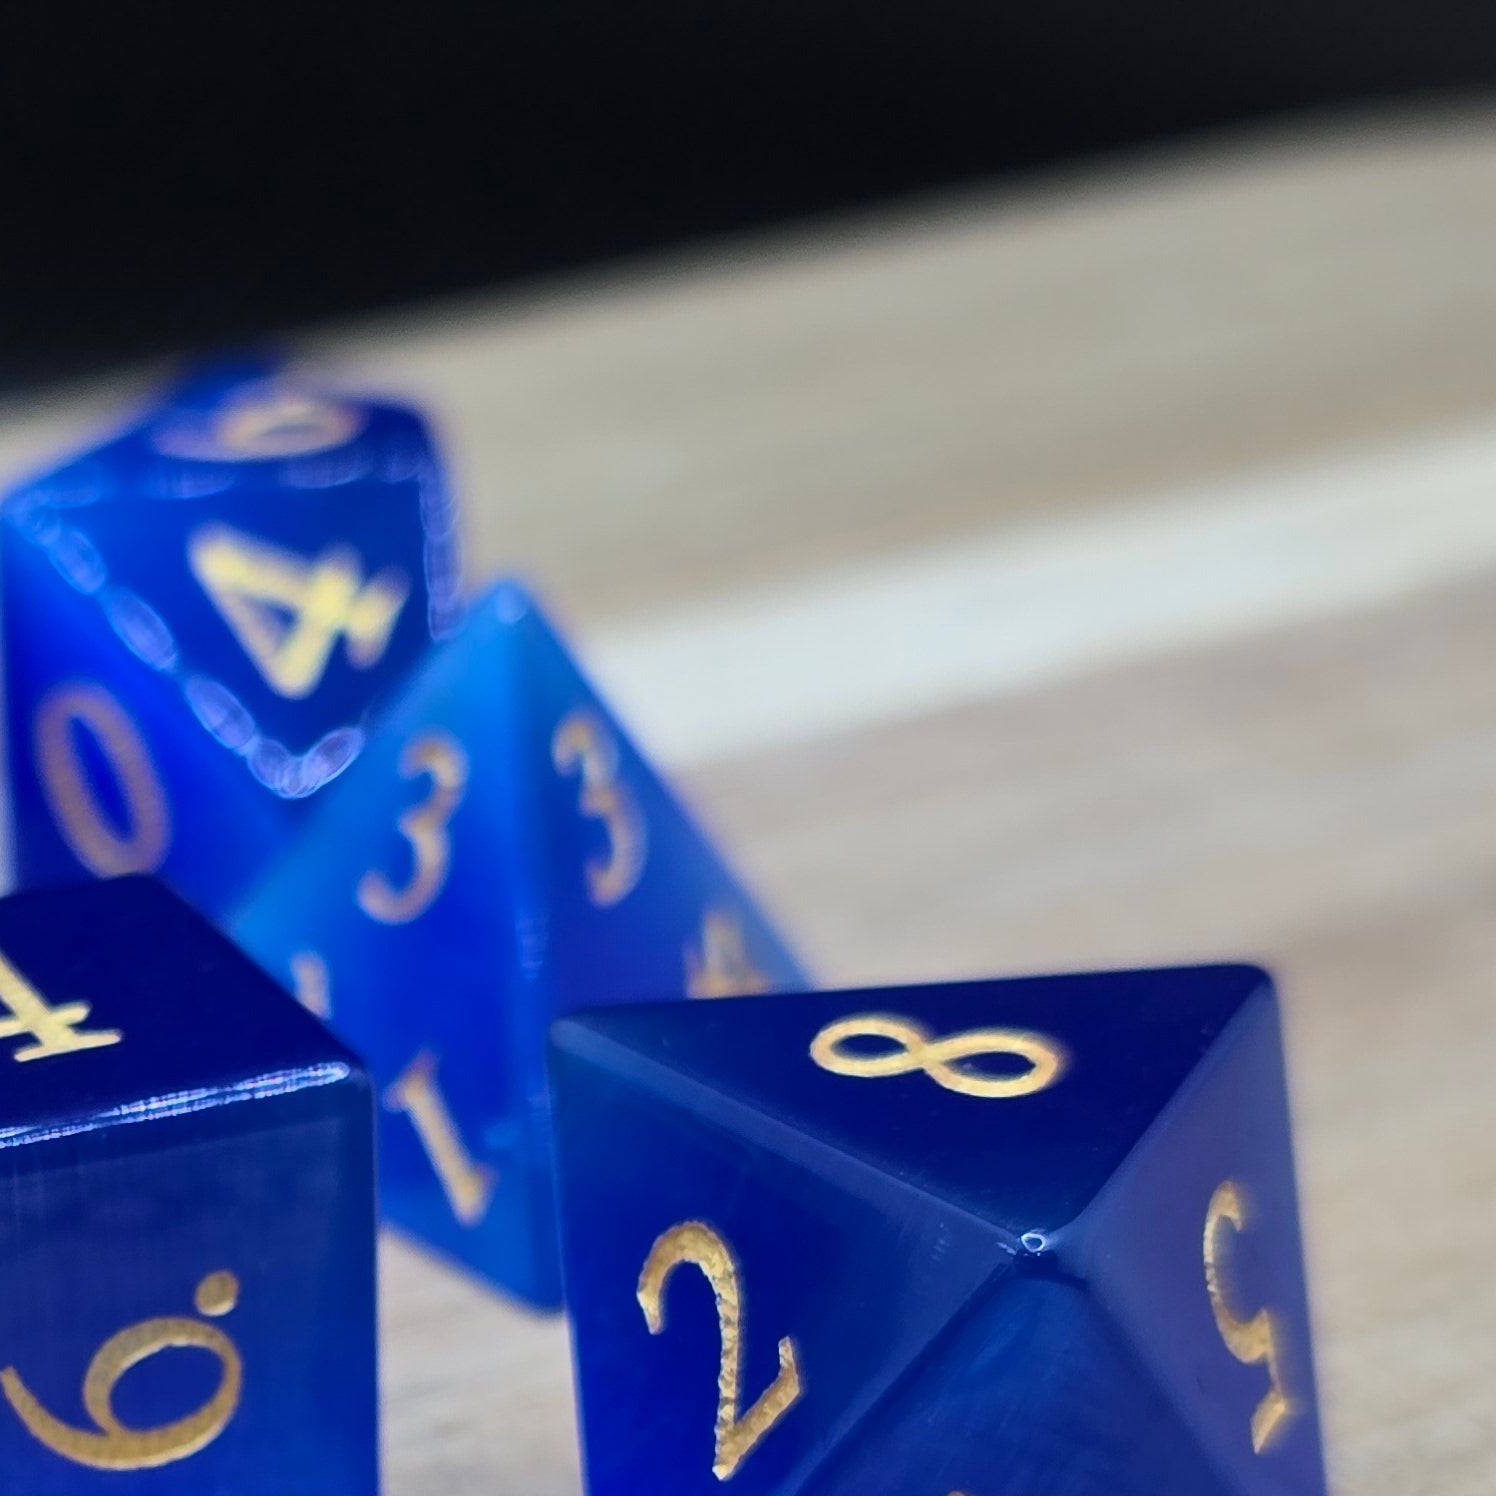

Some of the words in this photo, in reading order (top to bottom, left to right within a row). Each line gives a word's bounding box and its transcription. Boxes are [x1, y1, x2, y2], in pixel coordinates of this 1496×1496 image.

[186, 520, 412, 700] 4
[356, 733, 468, 926] 3
[551, 706, 646, 908] 3
[384, 1050, 496, 1226] 1
[808, 1014, 1068, 1098] 8
[636, 1220, 804, 1484] 2
[1202, 1180, 1290, 1456] 5
